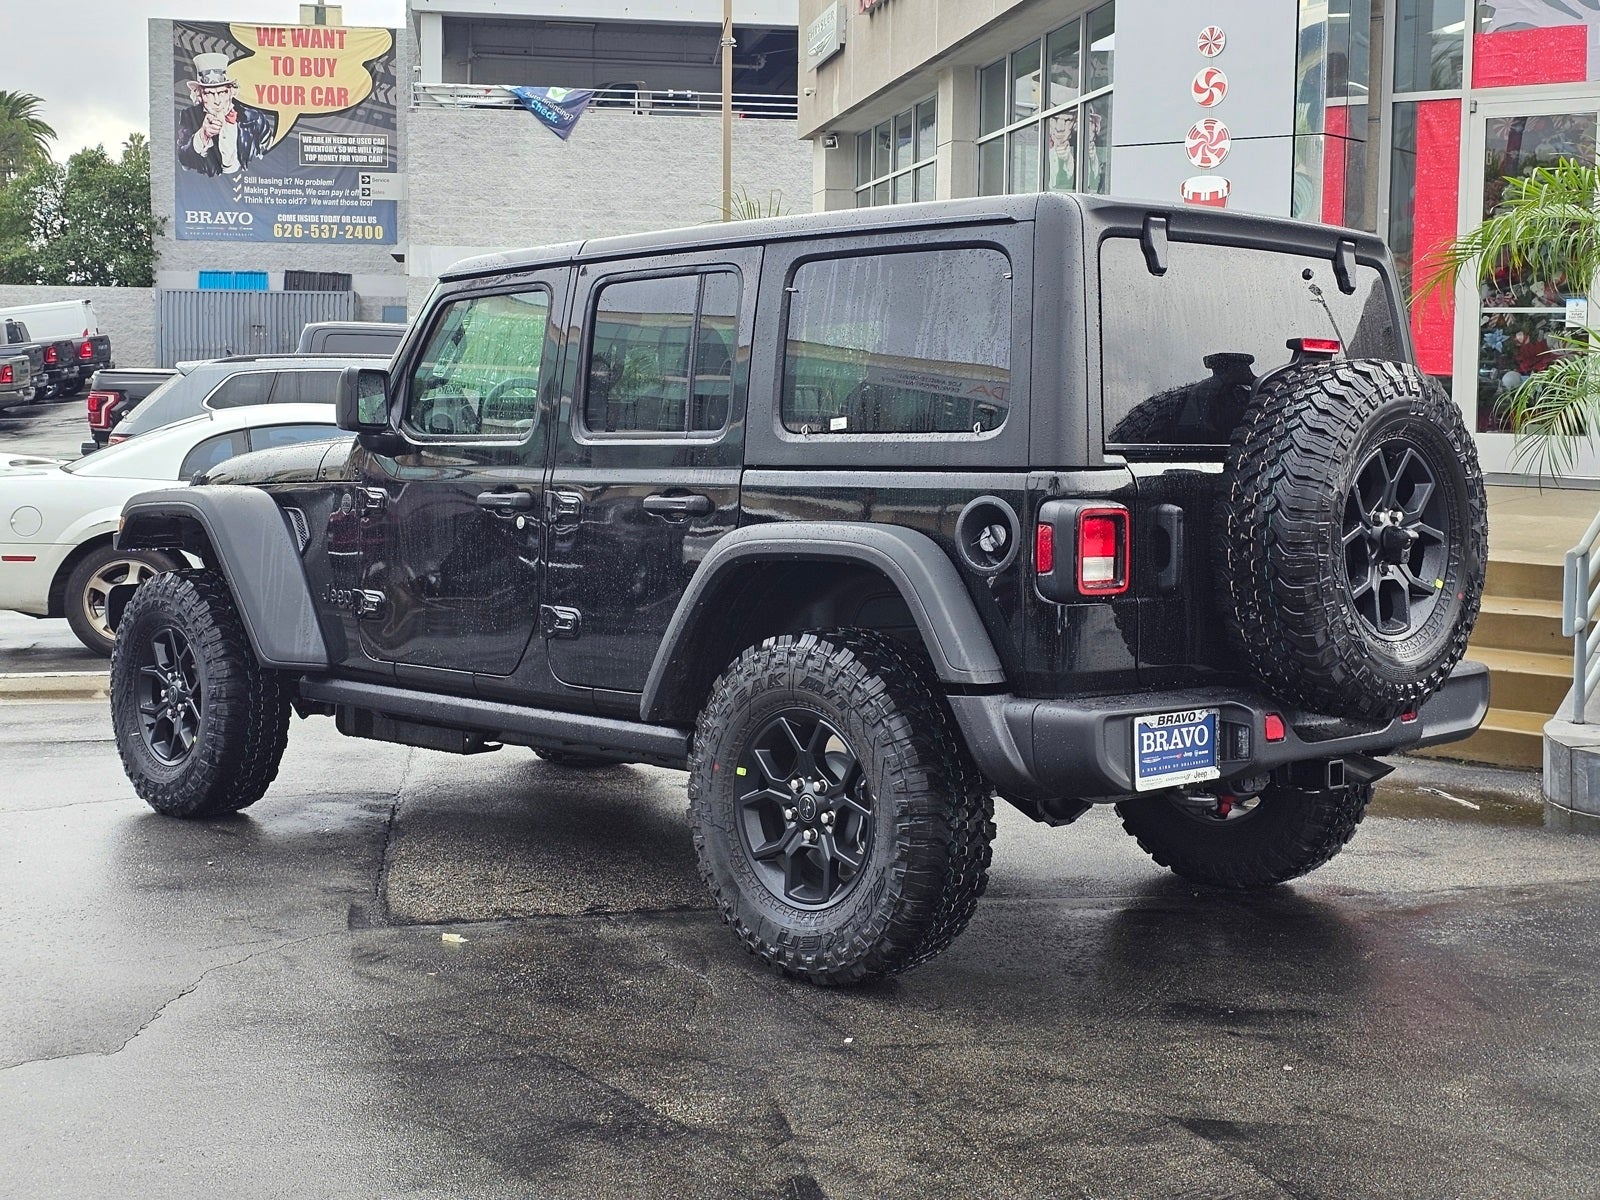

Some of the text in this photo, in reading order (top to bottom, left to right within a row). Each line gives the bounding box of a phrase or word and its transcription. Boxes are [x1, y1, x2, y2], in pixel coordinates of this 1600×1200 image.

[256, 27, 347, 49] WE WANT
[270, 56, 337, 77] TO BUY
[255, 84, 349, 107] YOUR CAR
[531, 100, 558, 124] Check.
[302, 136, 386, 146] WE ARE IN NEED OF USED CAR
[303, 145, 338, 154] INVENTORY,
[338, 146, 347, 154] SO
[347, 146, 358, 154] WE
[358, 146, 372, 154] WILL
[305, 153, 317, 161] TOP
[317, 154, 339, 162] MONEY
[339, 154, 351, 162] FOR
[368, 155, 383, 163] CAR!
[243, 176, 335, 187] Still leasing it? No problem!
[243, 186, 268, 196] Making
[269, 186, 304, 197] Payments,
[305, 188, 317, 196] We
[344, 188, 350, 196] it
[244, 195, 263, 204] Think
[264, 196, 275, 204] it's
[275, 197, 287, 205] too
[288, 197, 308, 205] old??
[310, 198, 321, 206] We
[359, 199, 373, 207] too!
[185, 210, 253, 225] BRAVO
[277, 214, 377, 224] COME INSIDE TODAY OR CALL US
[273, 223, 384, 240] 626-537-2400
[1157, 712, 1196, 726] BRAVO
[1141, 725, 1209, 754] BRAVO
[1194, 770, 1208, 779] Jeep
